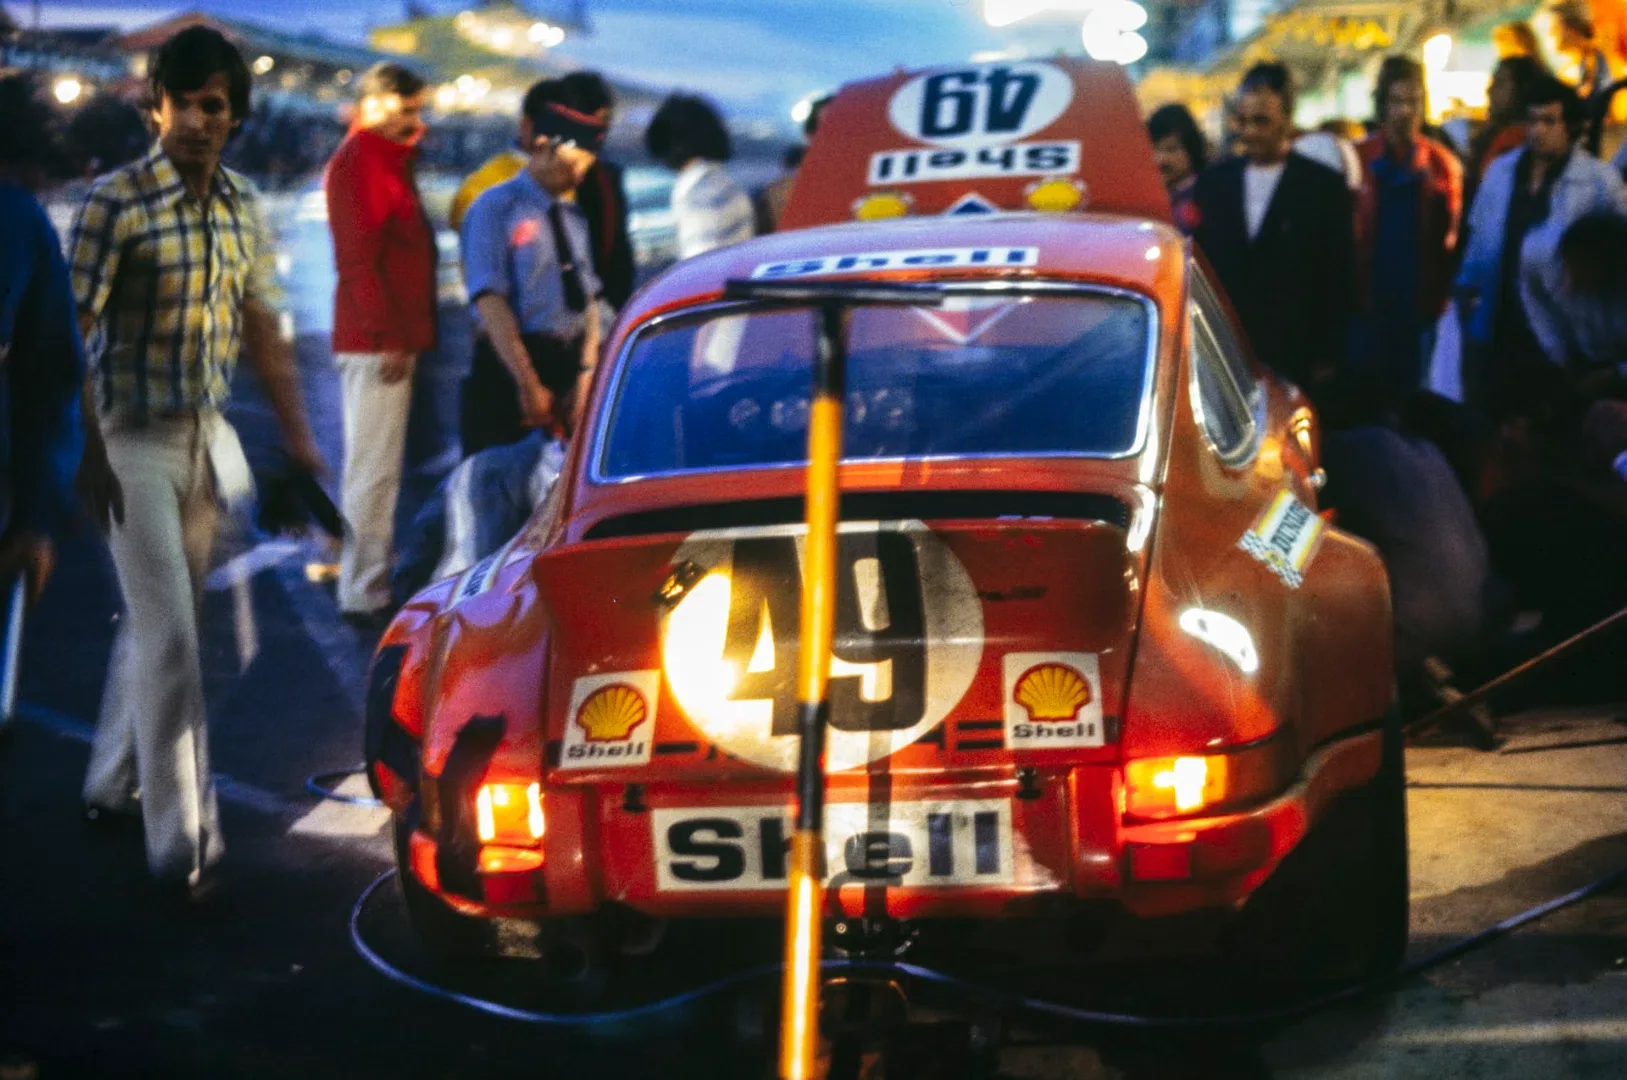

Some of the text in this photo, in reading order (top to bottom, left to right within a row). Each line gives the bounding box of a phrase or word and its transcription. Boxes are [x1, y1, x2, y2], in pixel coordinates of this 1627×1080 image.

[920, 67, 1041, 137] 49
[877, 147, 1070, 178] Shell
[763, 250, 1026, 277] Shell
[724, 531, 928, 737] 49
[1012, 723, 1096, 738] Shell
[567, 742, 645, 758] Shell
[667, 811, 999, 882] Shell
